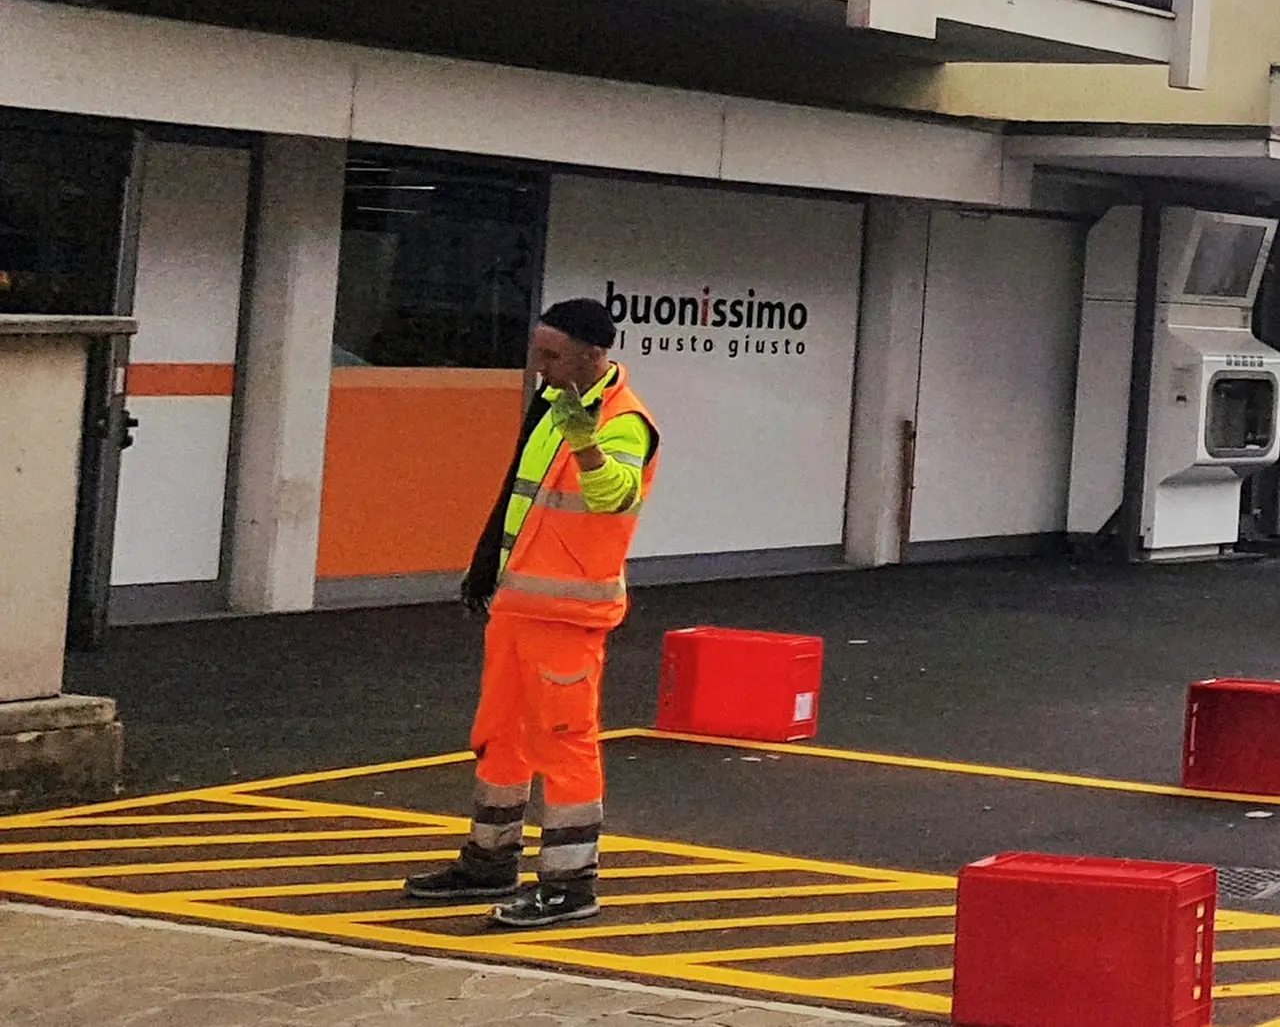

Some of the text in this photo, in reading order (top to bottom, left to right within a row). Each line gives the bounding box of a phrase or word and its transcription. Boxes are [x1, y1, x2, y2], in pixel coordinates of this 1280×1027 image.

[605, 280, 808, 331] buonissimo
[641, 335, 714, 356] gusto
[728, 334, 806, 358] giusto
